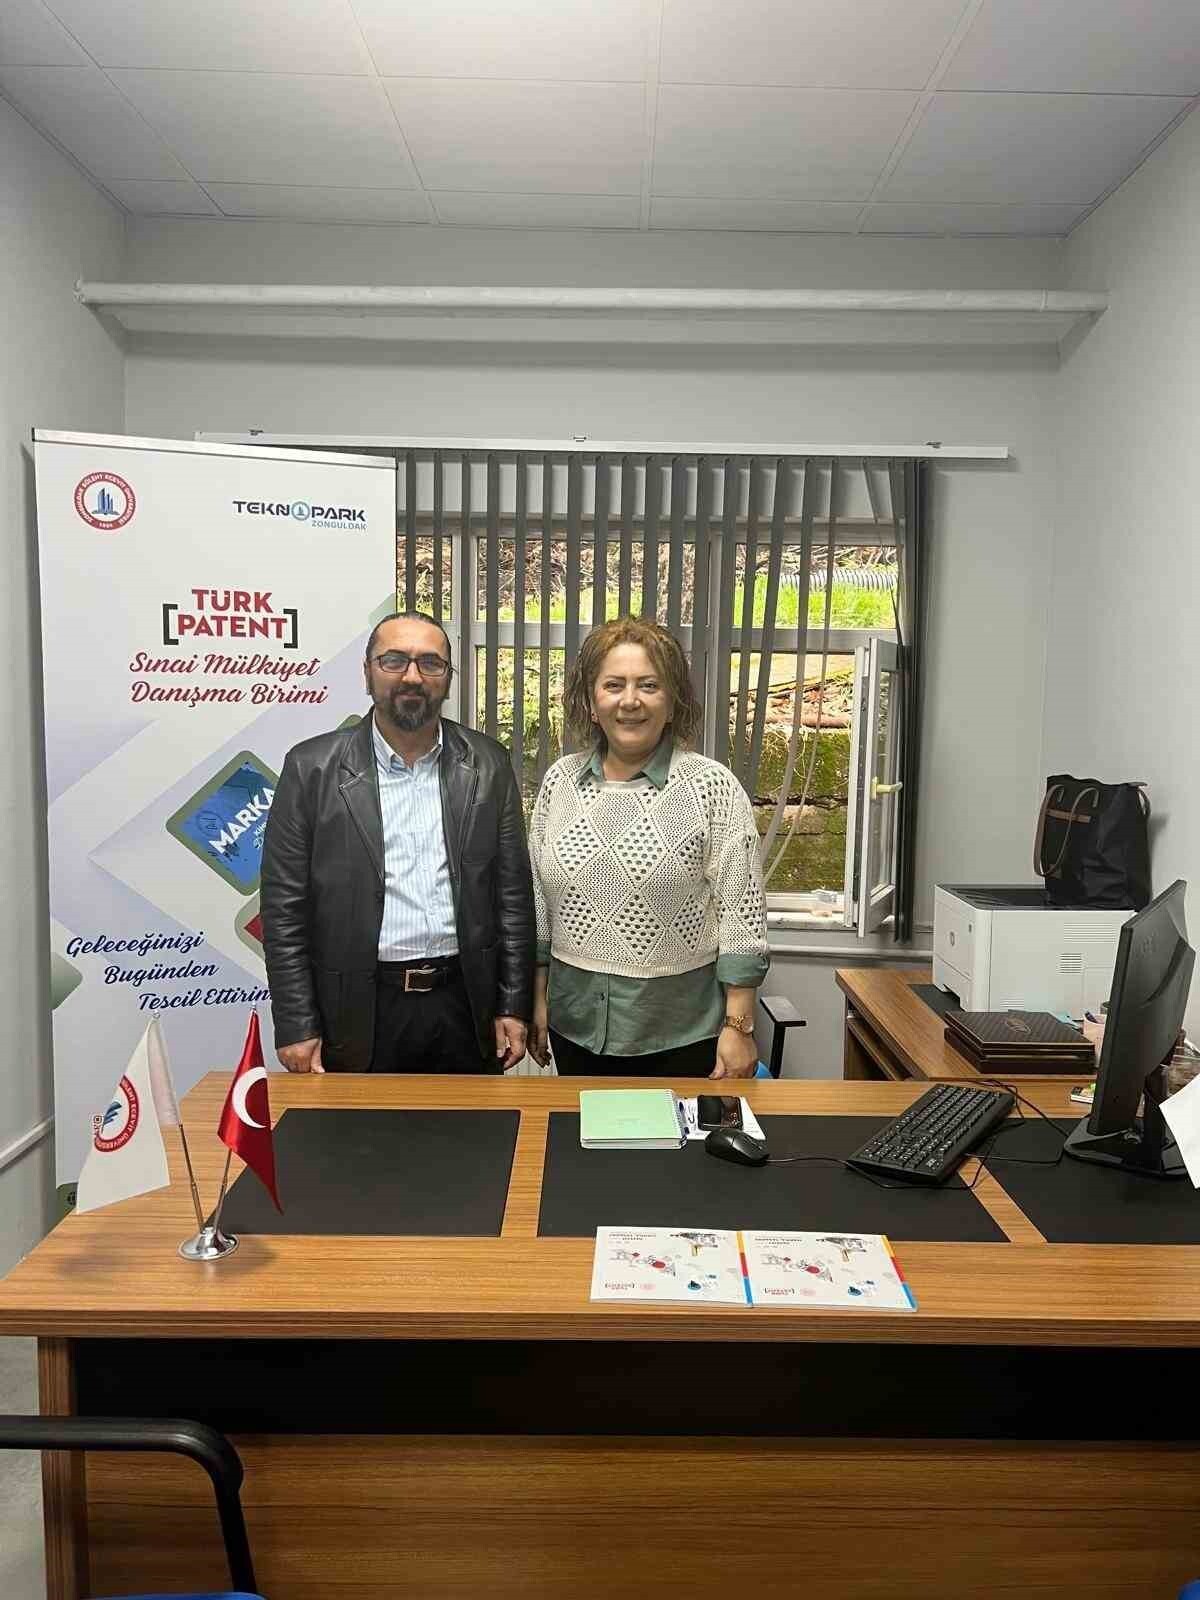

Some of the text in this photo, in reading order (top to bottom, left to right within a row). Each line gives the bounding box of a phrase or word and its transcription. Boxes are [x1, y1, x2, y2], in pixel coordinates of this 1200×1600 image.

[311, 520, 367, 531] ZONGULDAK
[192, 589, 273, 613] TÜRK
[128, 651, 321, 682] Sınai Mülkiyet
[130, 681, 329, 708] Danışma Birimi
[208, 787, 275, 854] MARKA
[66, 931, 205, 958] Geleceğinizi
[104, 960, 219, 987] Bugünden
[139, 988, 203, 1010] Tescil
